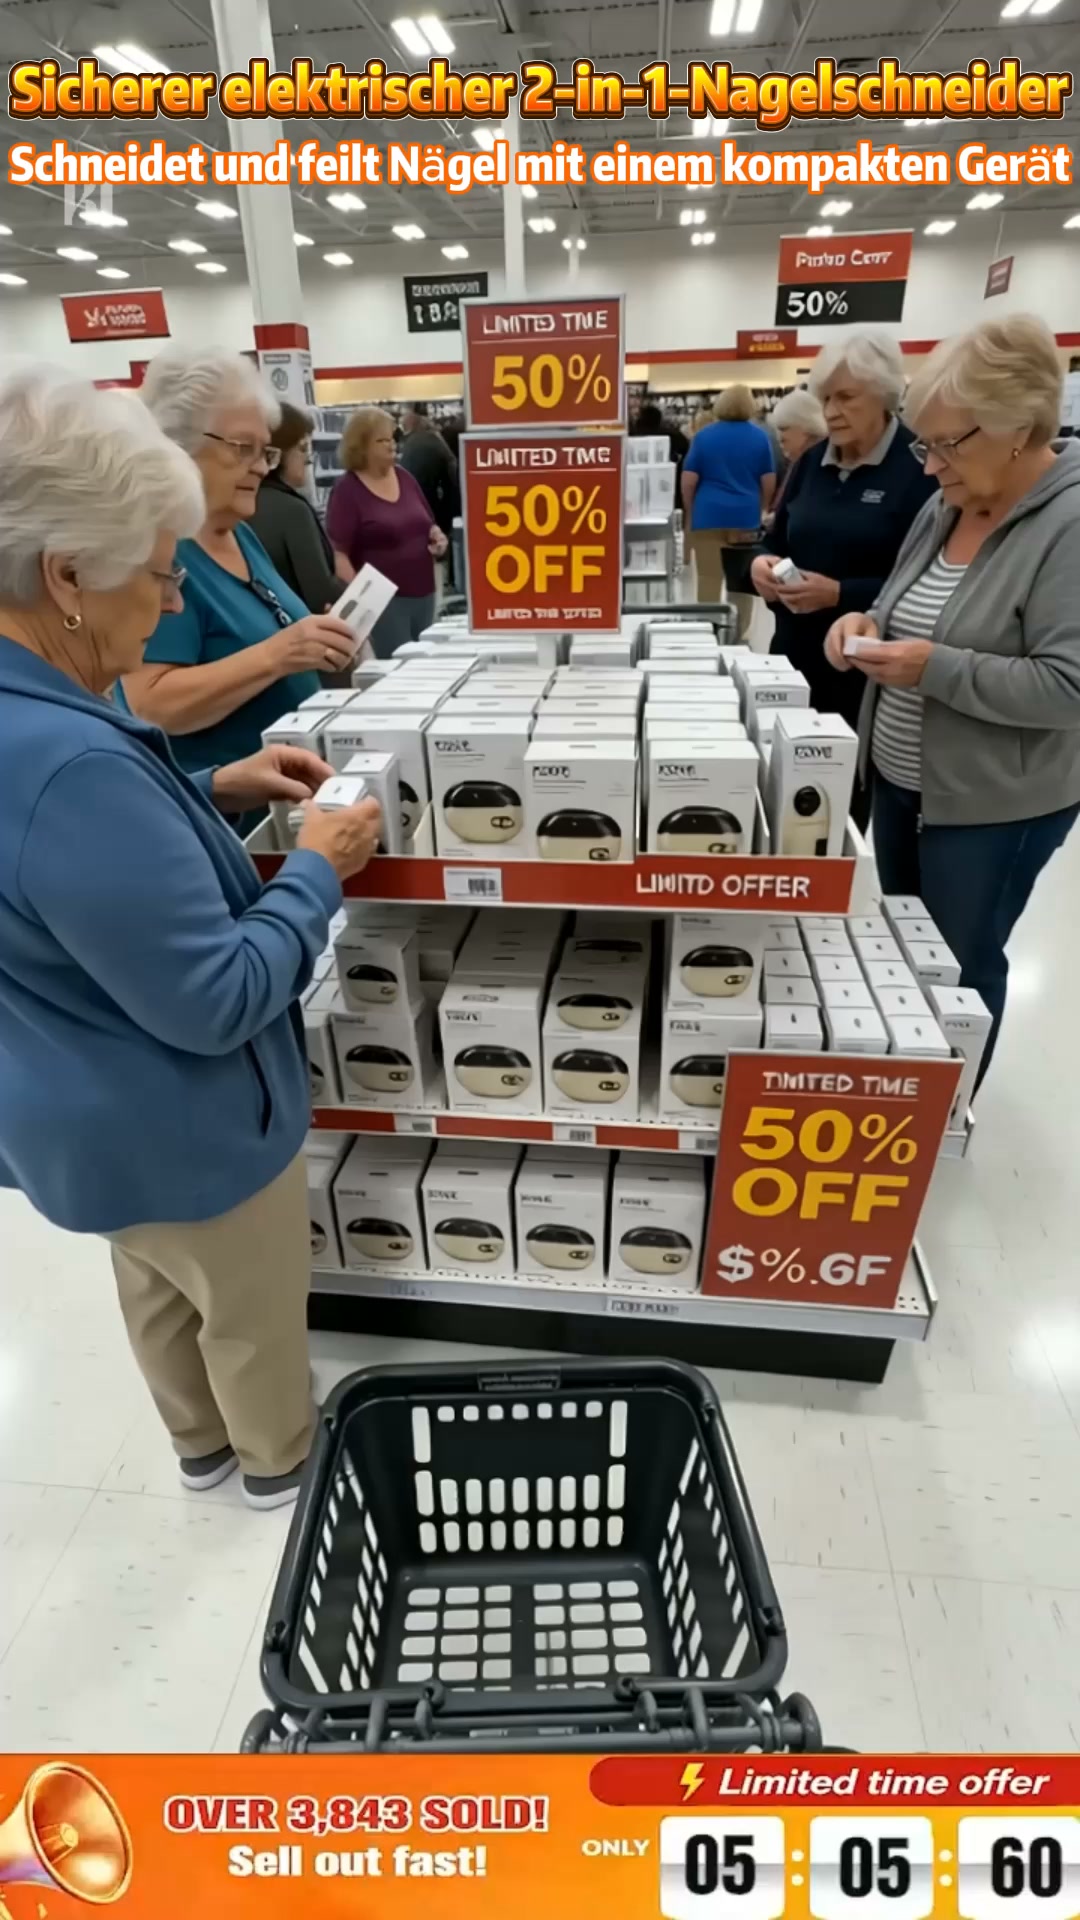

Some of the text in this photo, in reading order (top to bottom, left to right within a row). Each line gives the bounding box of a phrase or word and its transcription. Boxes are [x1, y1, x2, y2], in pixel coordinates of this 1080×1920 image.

[786, 288, 849, 318] 50%
[491, 353, 612, 411] 50%
[484, 484, 607, 537] 50%
[485, 544, 605, 594] OFF
[721, 873, 811, 899] OFFER
[739, 1106, 919, 1165] 50%
[731, 1166, 911, 1223] OFF
